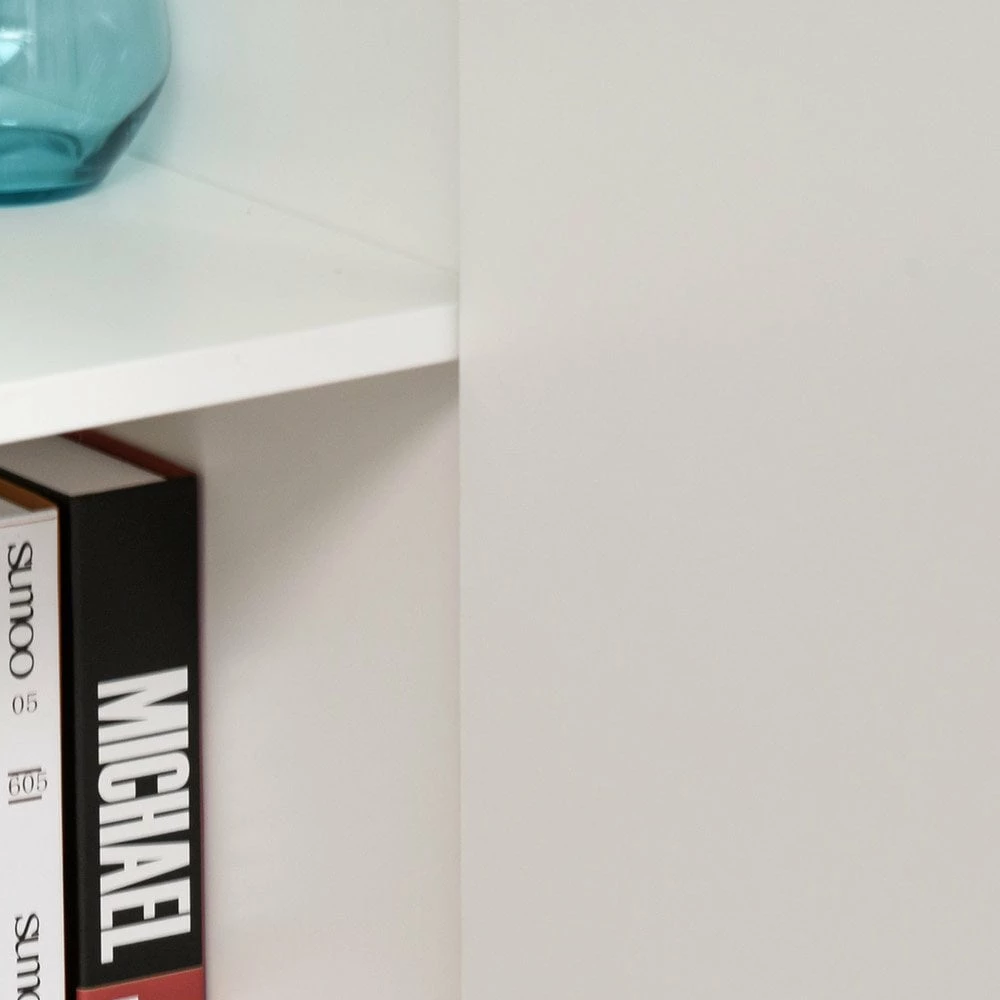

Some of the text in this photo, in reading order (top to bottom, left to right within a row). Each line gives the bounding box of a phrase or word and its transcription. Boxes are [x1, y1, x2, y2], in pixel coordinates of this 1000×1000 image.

[8, 541, 38, 715] sumoo 05
[8, 771, 48, 796] 605
[97, 665, 191, 965] MICHAEL
